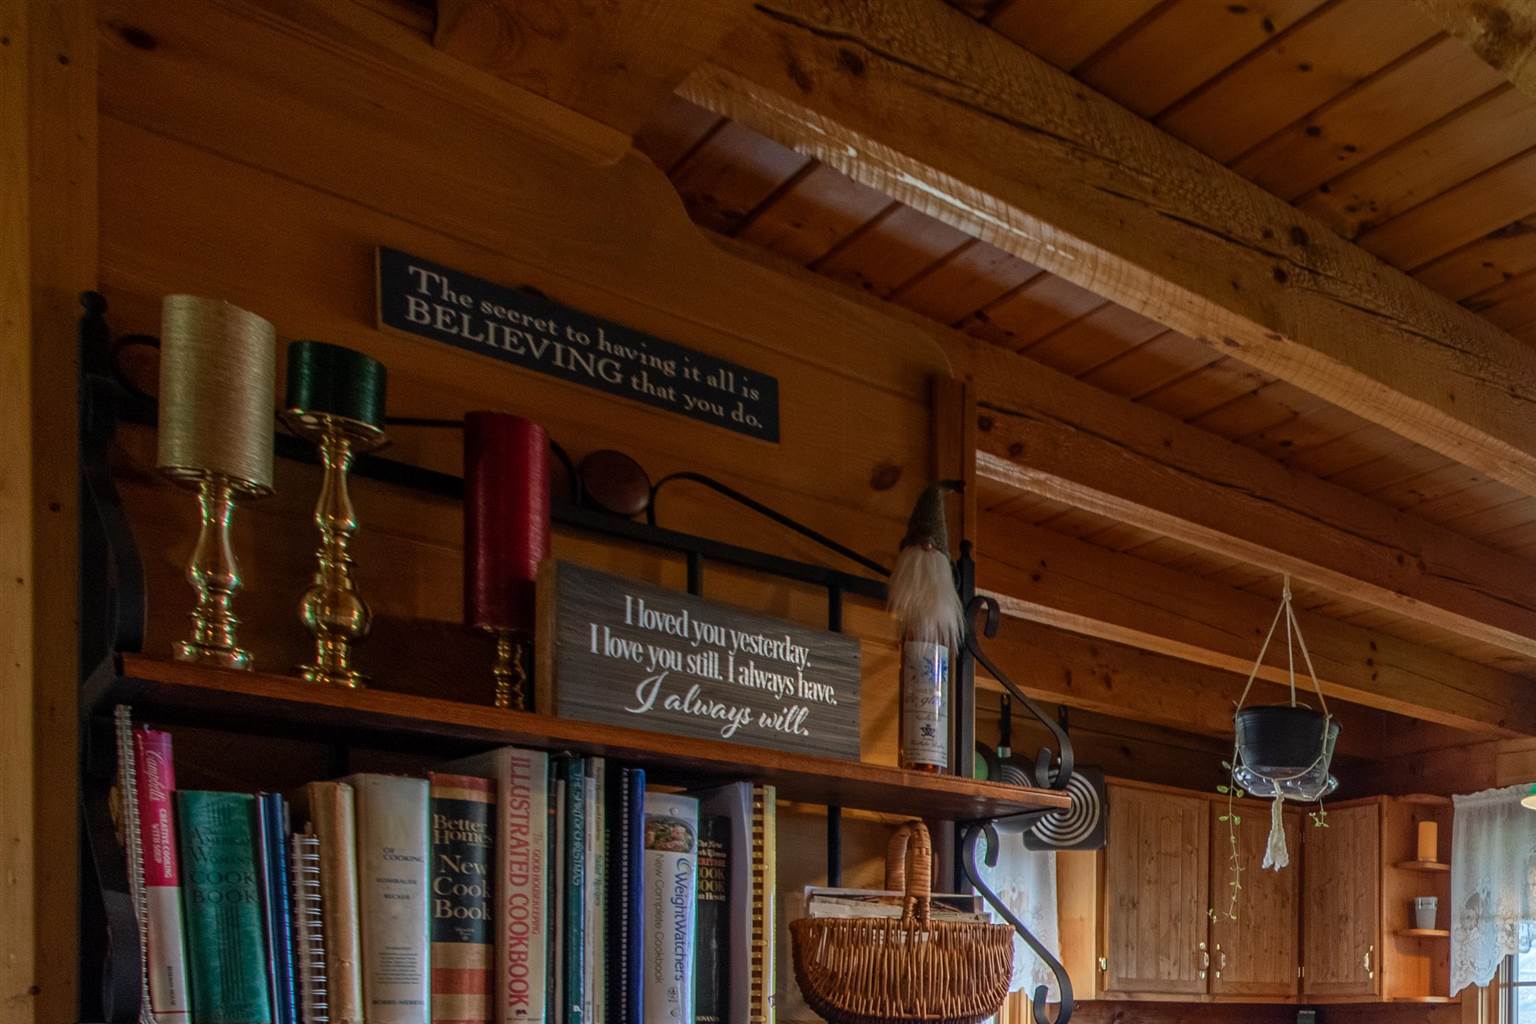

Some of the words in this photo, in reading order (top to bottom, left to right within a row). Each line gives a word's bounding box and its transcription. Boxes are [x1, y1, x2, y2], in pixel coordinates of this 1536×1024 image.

[408, 265, 473, 309] The
[480, 299, 557, 337] secret
[566, 321, 590, 346] to
[599, 328, 676, 376] having
[683, 356, 701, 382] it
[706, 367, 735, 395] all
[742, 376, 760, 401] is
[404, 295, 623, 385] BELIEVING
[631, 371, 676, 401] that
[682, 395, 725, 420] you
[731, 402, 764, 429] do.
[623, 594, 634, 626] I
[638, 598, 689, 634] loved
[692, 619, 727, 648] you
[729, 626, 812, 670] yesterday.
[589, 623, 599, 655] I
[603, 627, 643, 663] love
[647, 643, 683, 673] you
[687, 650, 724, 681] still.
[728, 656, 736, 682] I
[738, 660, 795, 701] always
[799, 675, 838, 706] have.
[625, 671, 669, 715] I
[664, 684, 755, 739] always
[758, 705, 810, 737] will.
[160, 808, 169, 844] CREATIVE
[433, 814, 488, 833] Better
[510, 756, 530, 887] ILLUSTRATED
[163, 846, 172, 879] COOKING
[433, 876, 491, 899] Cook
[440, 854, 488, 876] New
[654, 854, 664, 876] New
[435, 899, 492, 921] Book
[654, 880, 665, 929] Complete
[670, 872, 689, 982] WeightWatchers
[508, 893, 530, 1008] COOKBOOK
[654, 931, 665, 984] Cookbook
